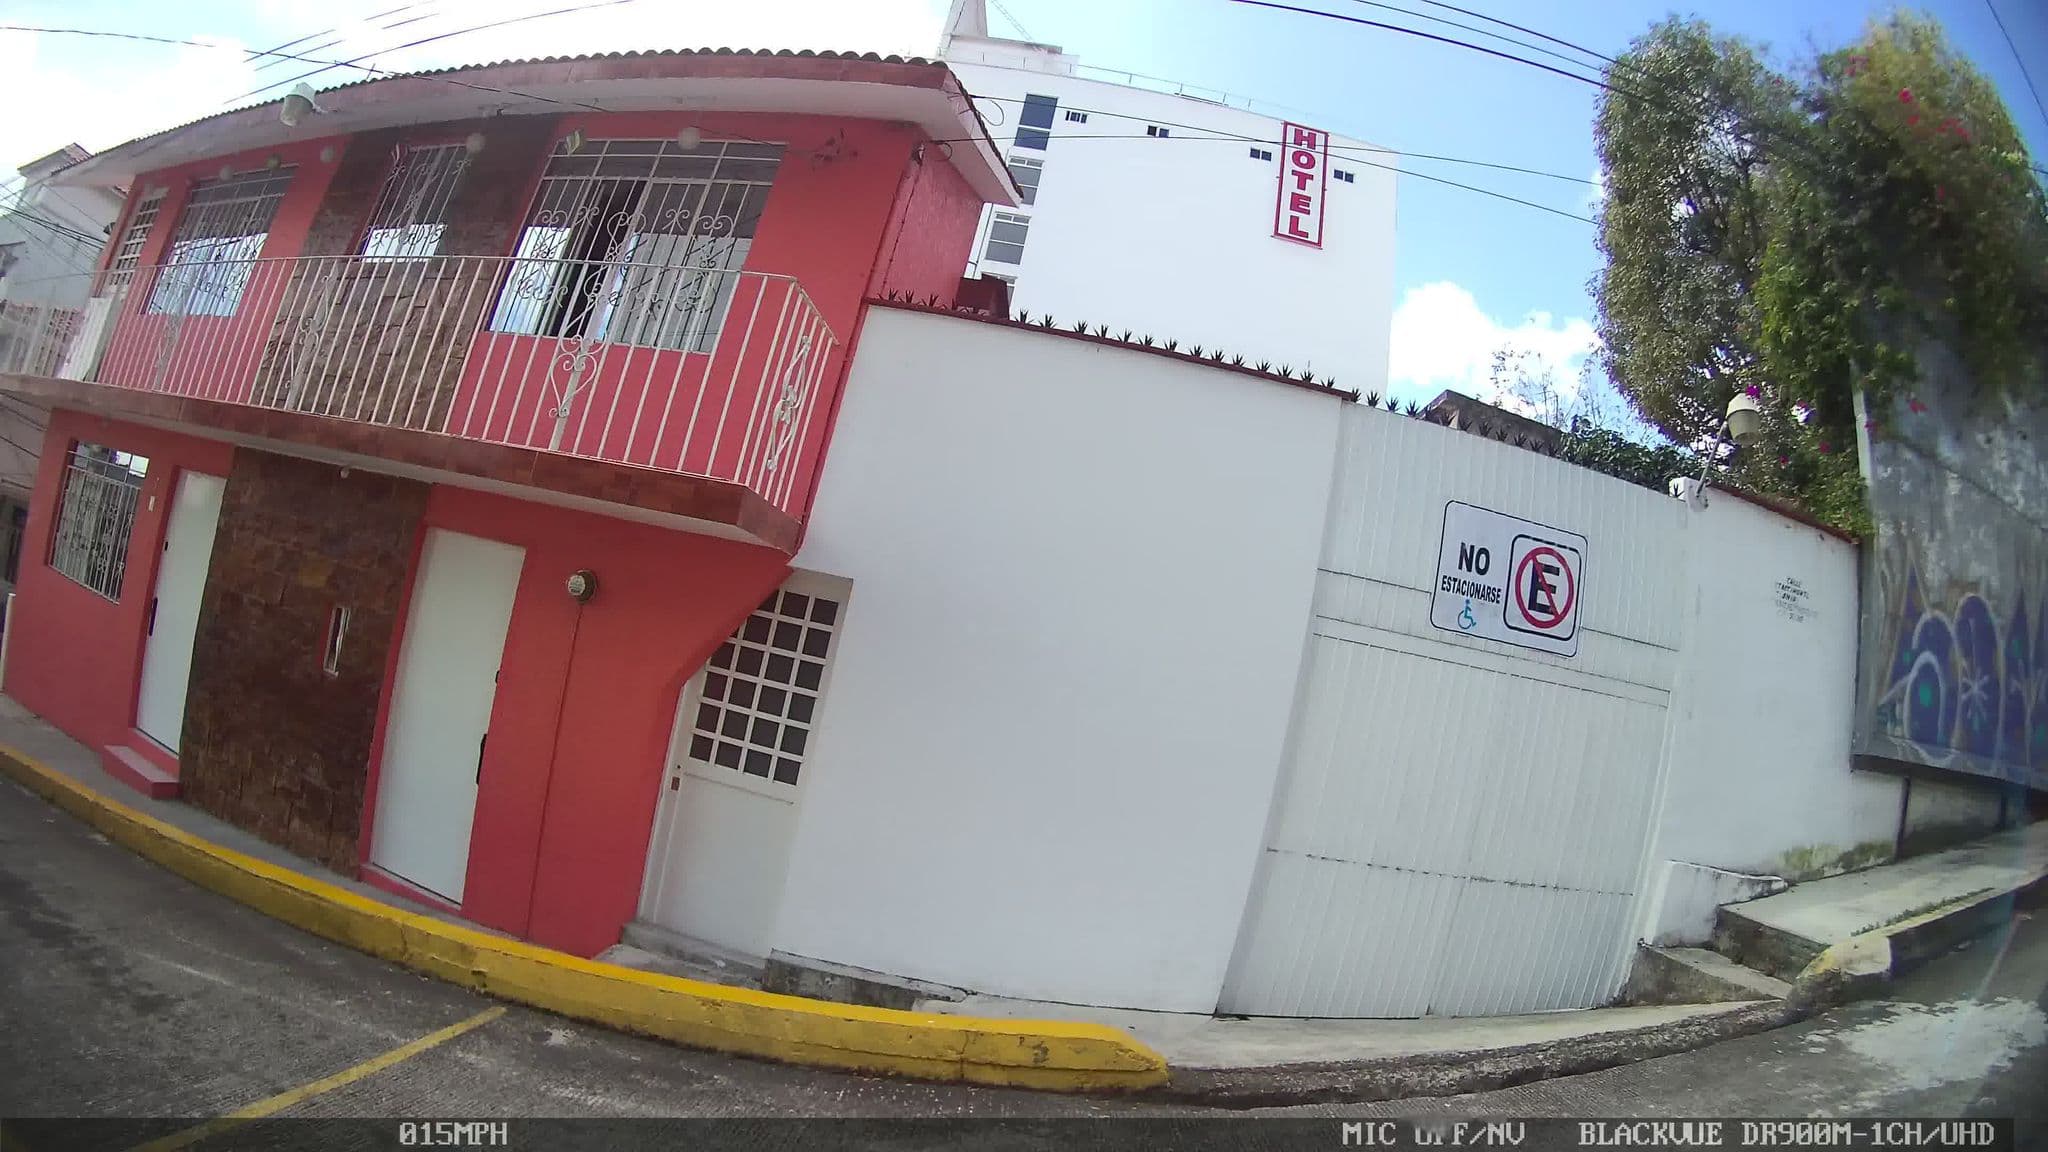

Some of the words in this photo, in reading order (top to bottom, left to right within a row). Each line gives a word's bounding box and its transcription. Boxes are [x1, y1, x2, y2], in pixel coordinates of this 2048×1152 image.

[1288, 128, 1317, 239] HOTEL
[1458, 542, 1491, 576] NO
[1441, 574, 1502, 604] ESTACIONARSE
[1527, 560, 1560, 616] E
